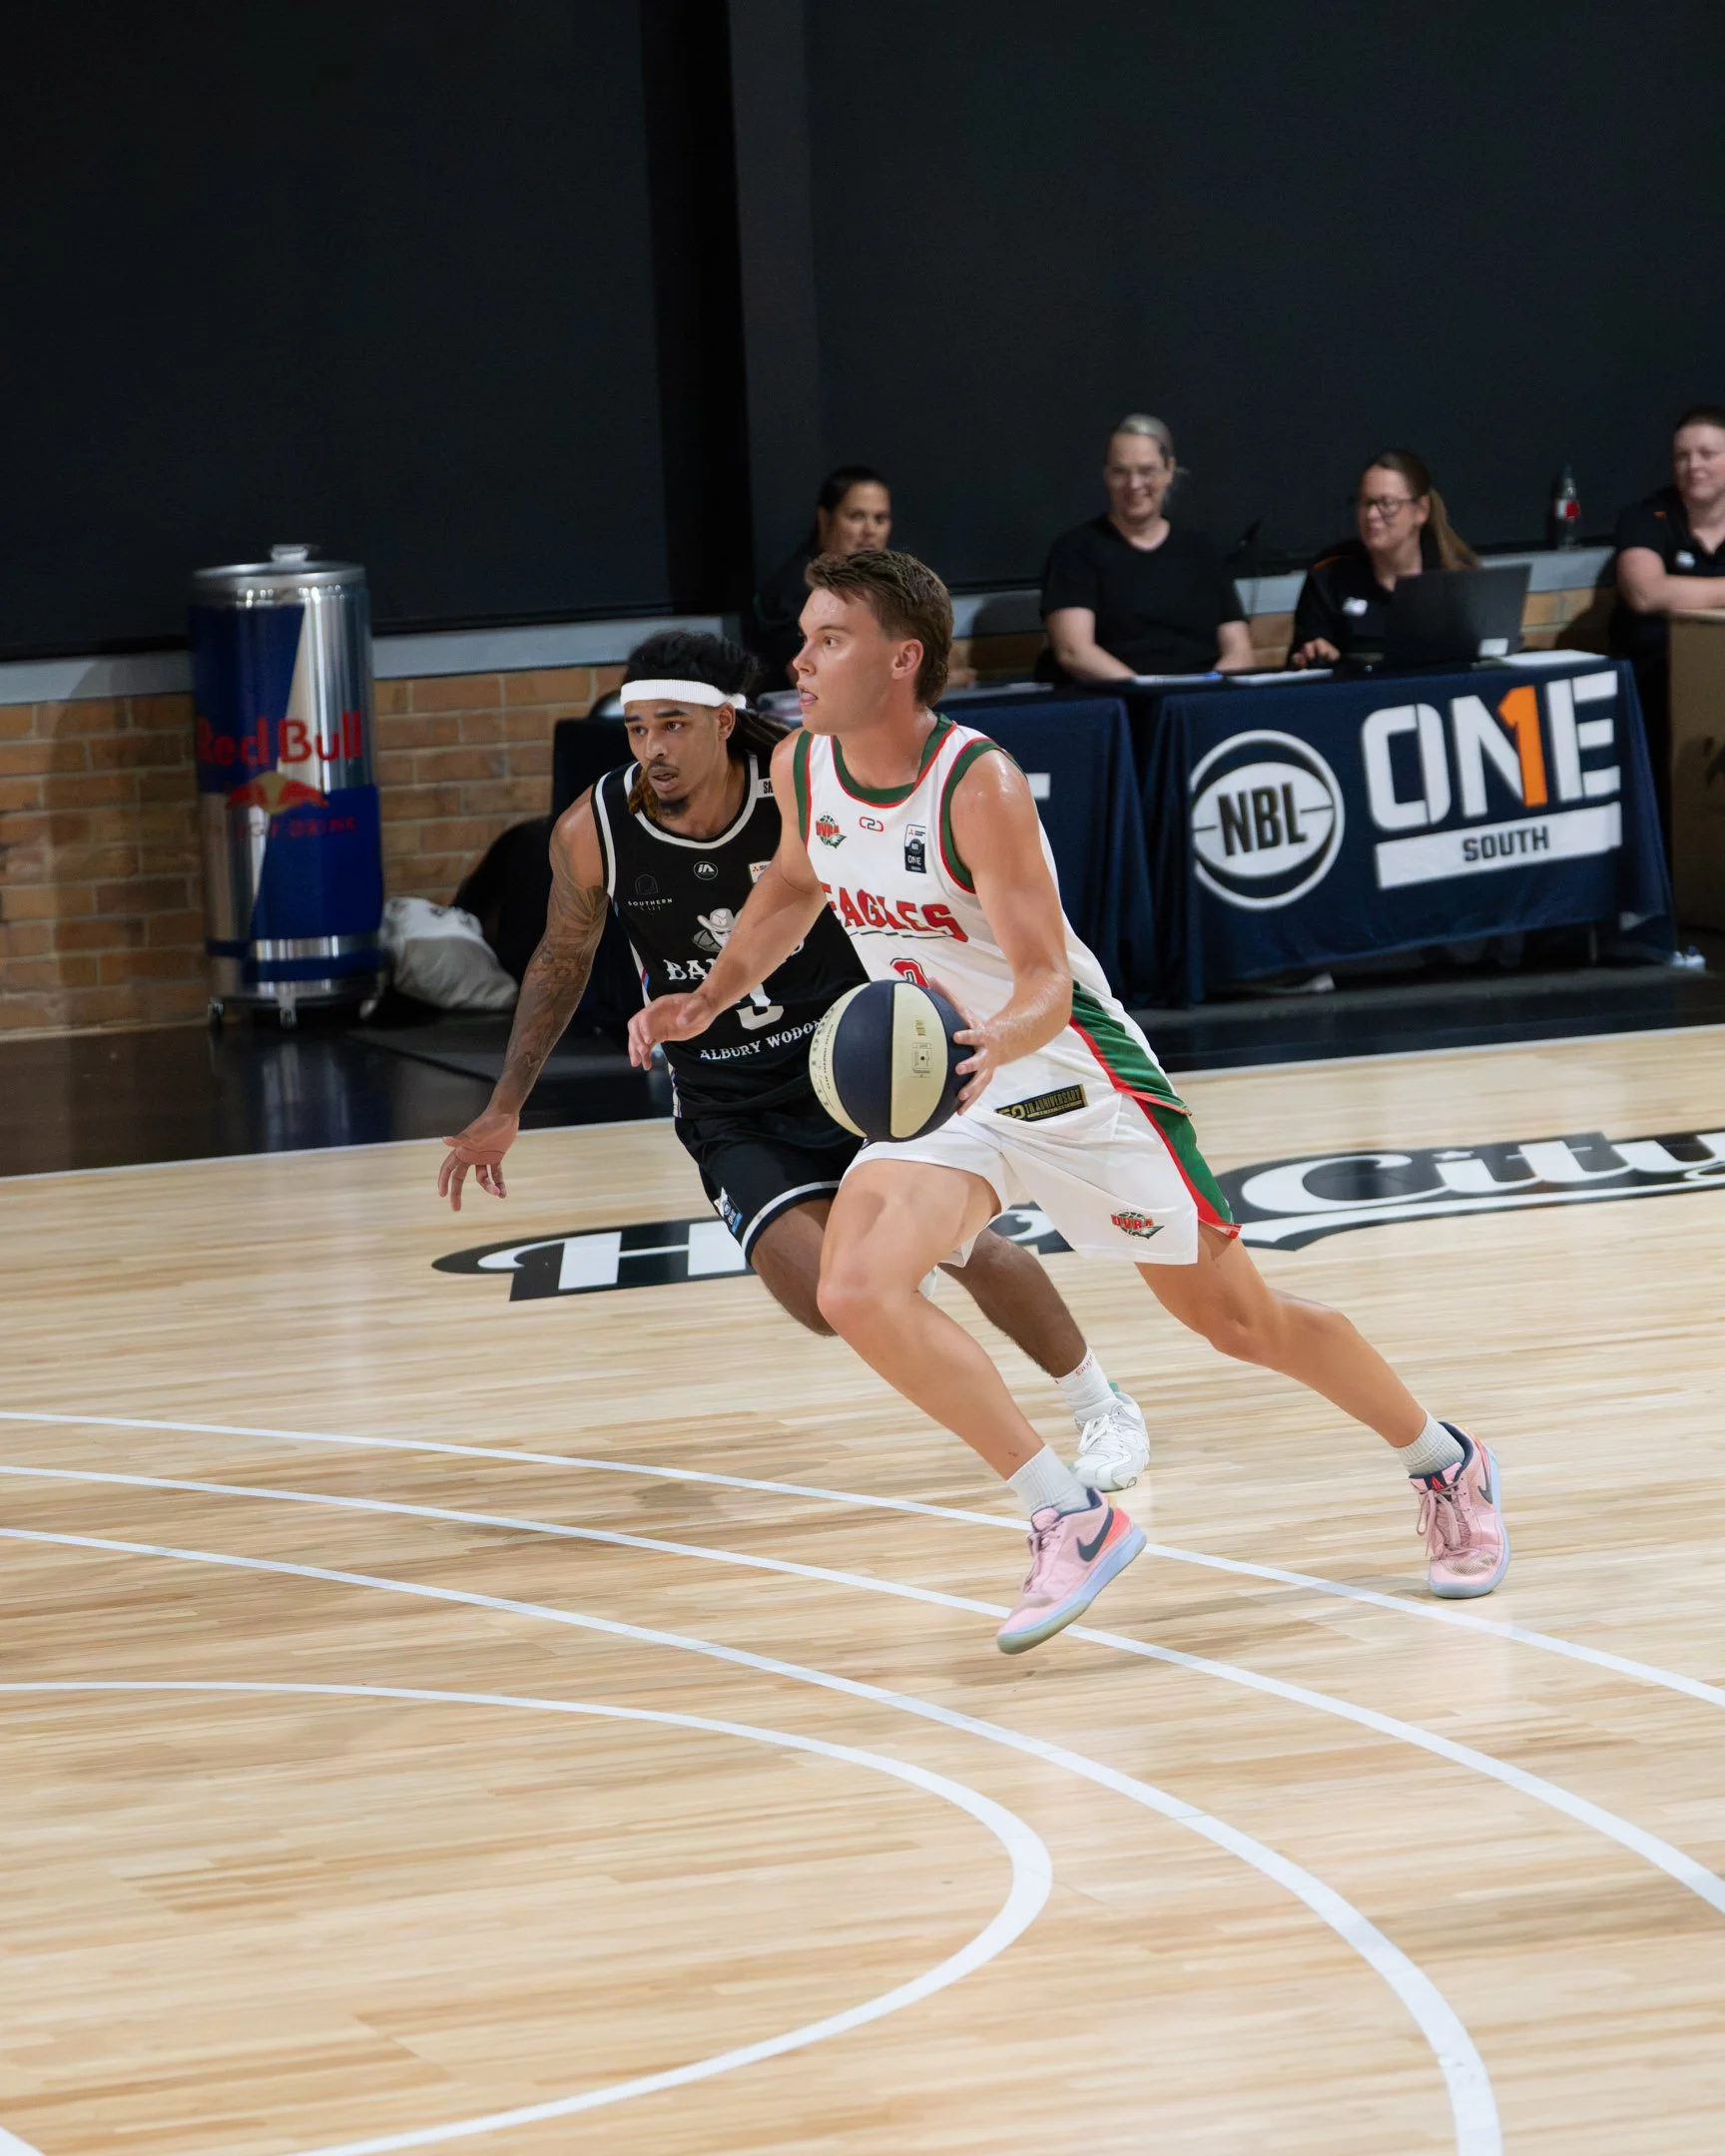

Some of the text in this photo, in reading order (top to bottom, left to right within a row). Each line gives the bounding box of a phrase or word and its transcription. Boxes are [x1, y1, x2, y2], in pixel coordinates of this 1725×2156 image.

[197, 710, 362, 767] Red Bull
[1218, 783, 1308, 857] NBL
[1462, 826, 1549, 862] SOUTH
[627, 897, 673, 906] SOUTHERN
[700, 1039, 762, 1061] ALBURY
